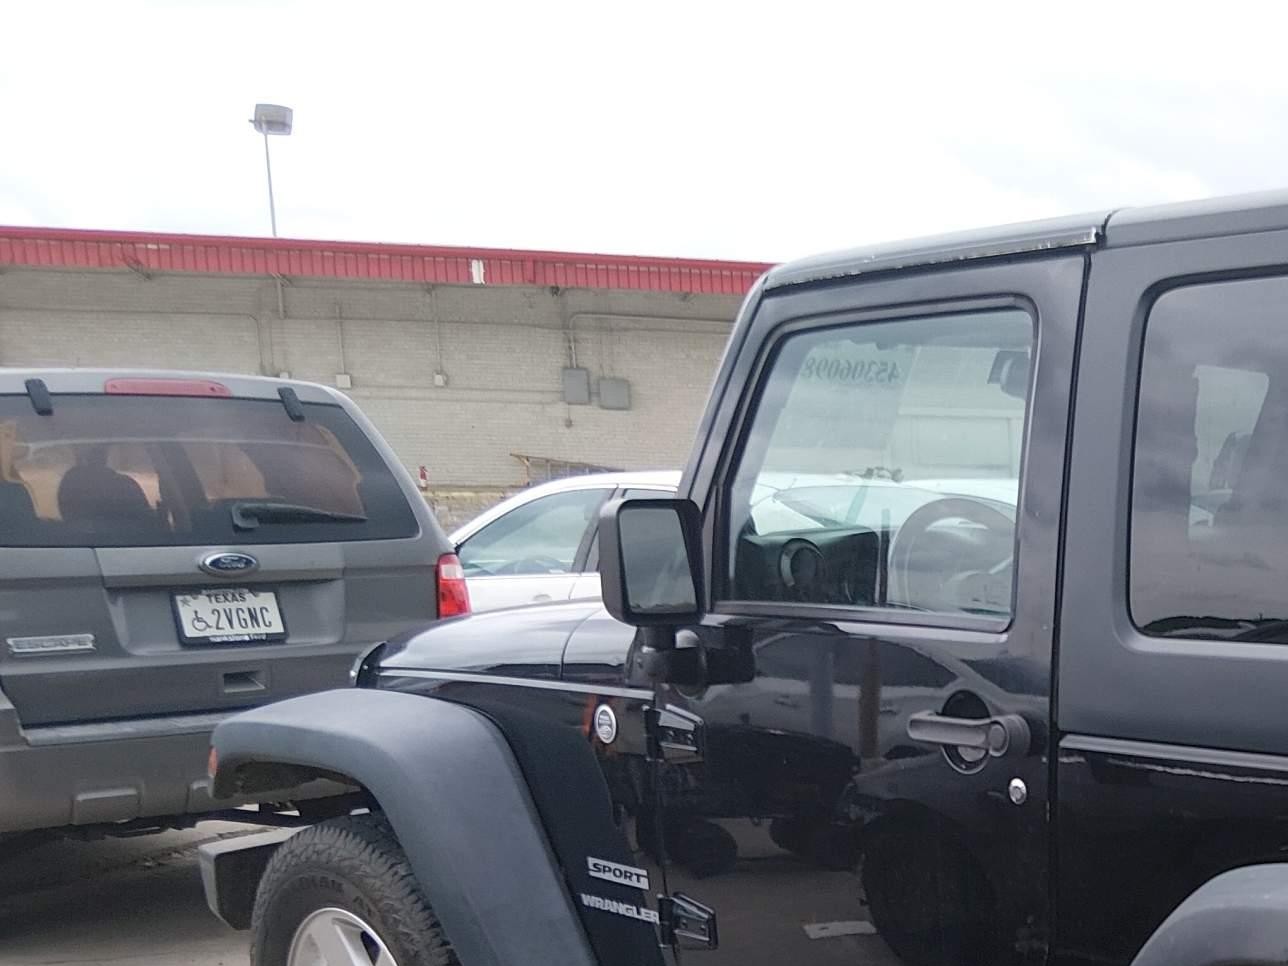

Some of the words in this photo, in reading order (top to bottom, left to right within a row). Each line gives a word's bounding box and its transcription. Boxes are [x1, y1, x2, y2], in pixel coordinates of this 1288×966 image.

[206, 592, 247, 604] TEXAS
[211, 606, 273, 630] 2VGNC
[592, 862, 643, 884] SPORT
[580, 893, 660, 925] WRANGLER
